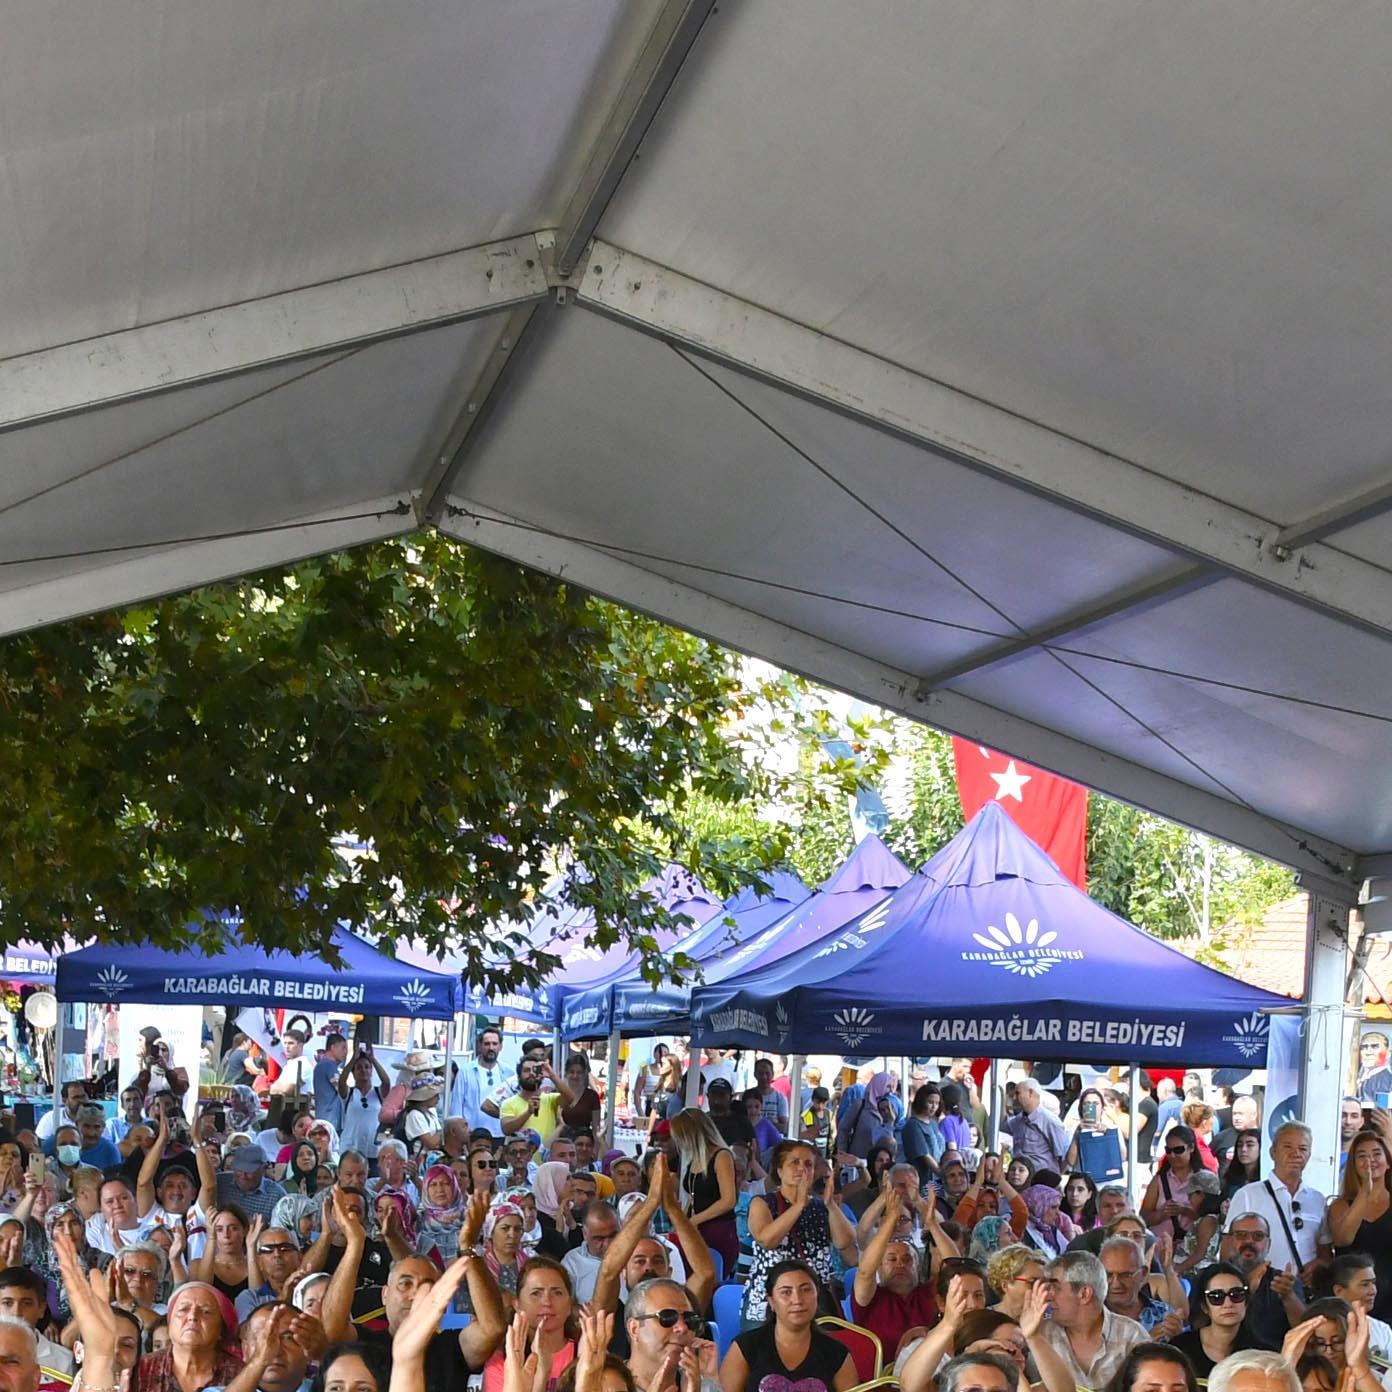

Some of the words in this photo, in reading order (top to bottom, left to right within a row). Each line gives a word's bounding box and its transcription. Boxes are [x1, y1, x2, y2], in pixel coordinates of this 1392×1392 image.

[164, 973, 270, 995] KARABAĞLAR
[274, 979, 364, 1003] BELEDİYESİ
[922, 1014, 1062, 1042] KARABAĞLAR
[1067, 1018, 1185, 1048] BELEDİYESİ
